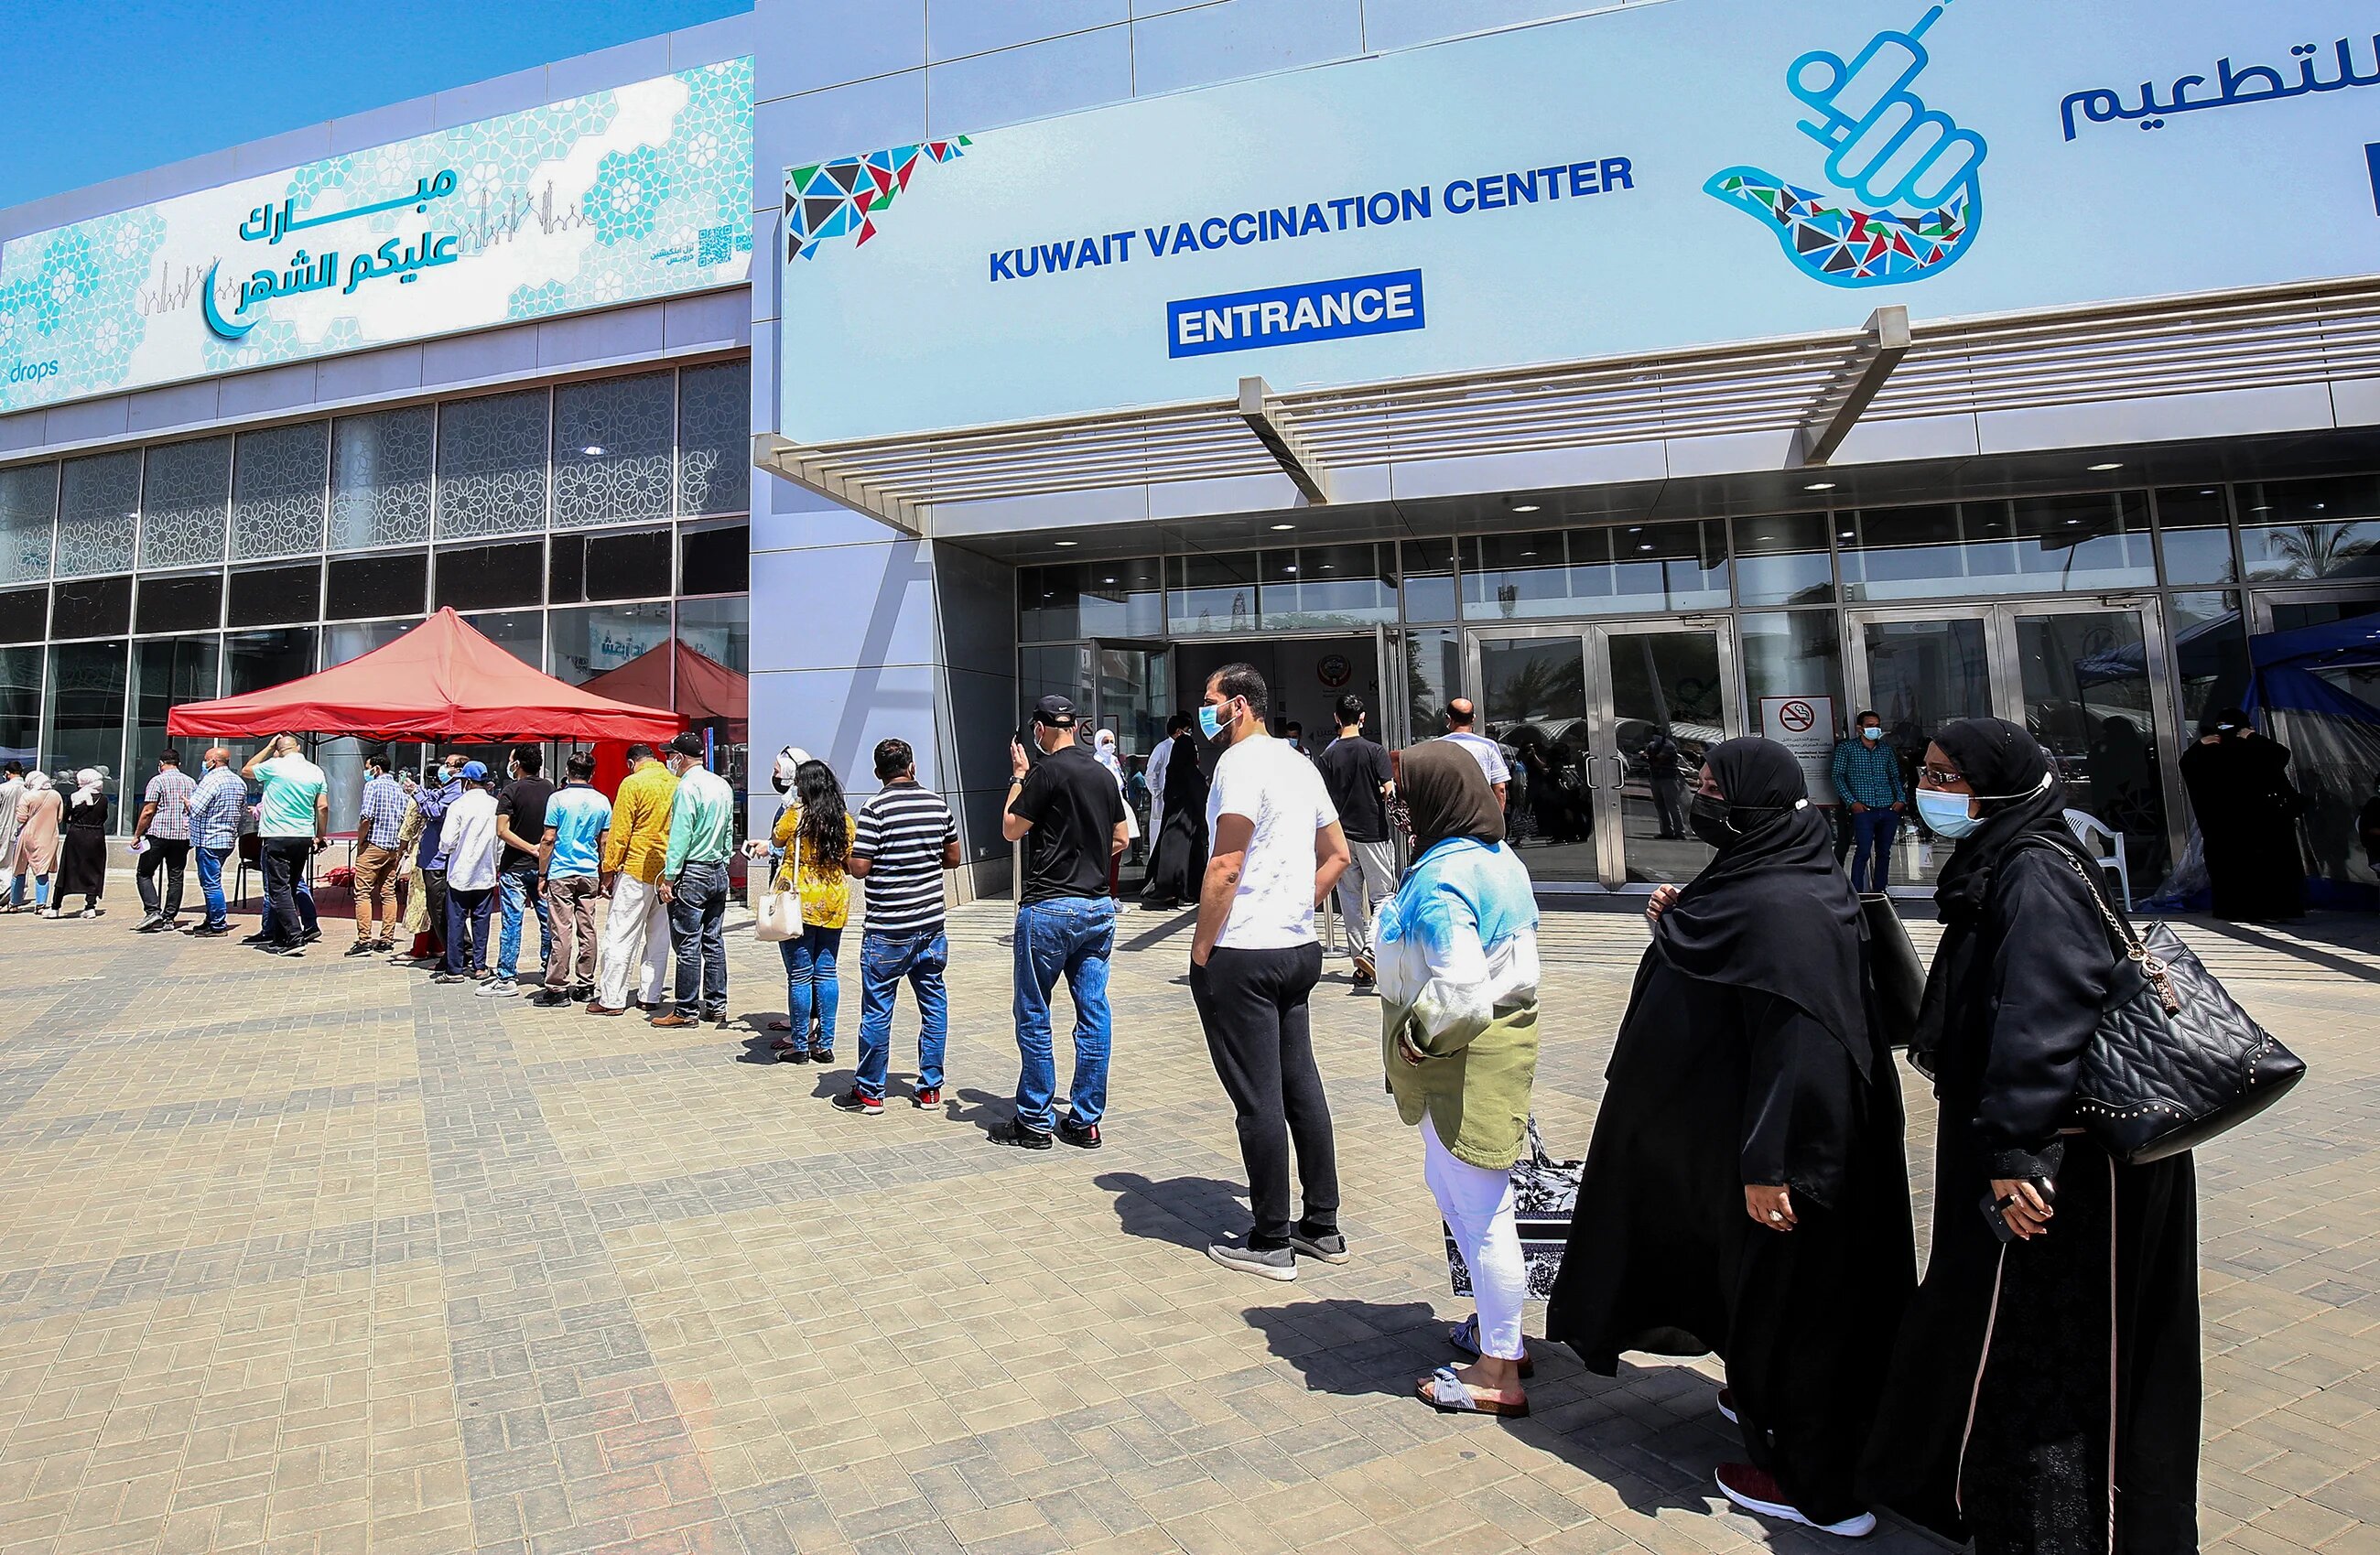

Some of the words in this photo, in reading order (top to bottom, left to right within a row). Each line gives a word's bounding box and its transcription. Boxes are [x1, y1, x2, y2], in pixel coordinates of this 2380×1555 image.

[2060, 33, 2380, 142] للتطعيم
[239, 168, 458, 244] مبارك
[990, 231, 1136, 282] KUWAIT
[1144, 186, 1432, 257] VACCINATION
[1444, 157, 1635, 214] CENTER
[234, 249, 339, 315] الشهر
[343, 232, 459, 295] عليكم
[1177, 283, 1415, 345] ENTRANCE
[10, 360, 59, 384] drops
